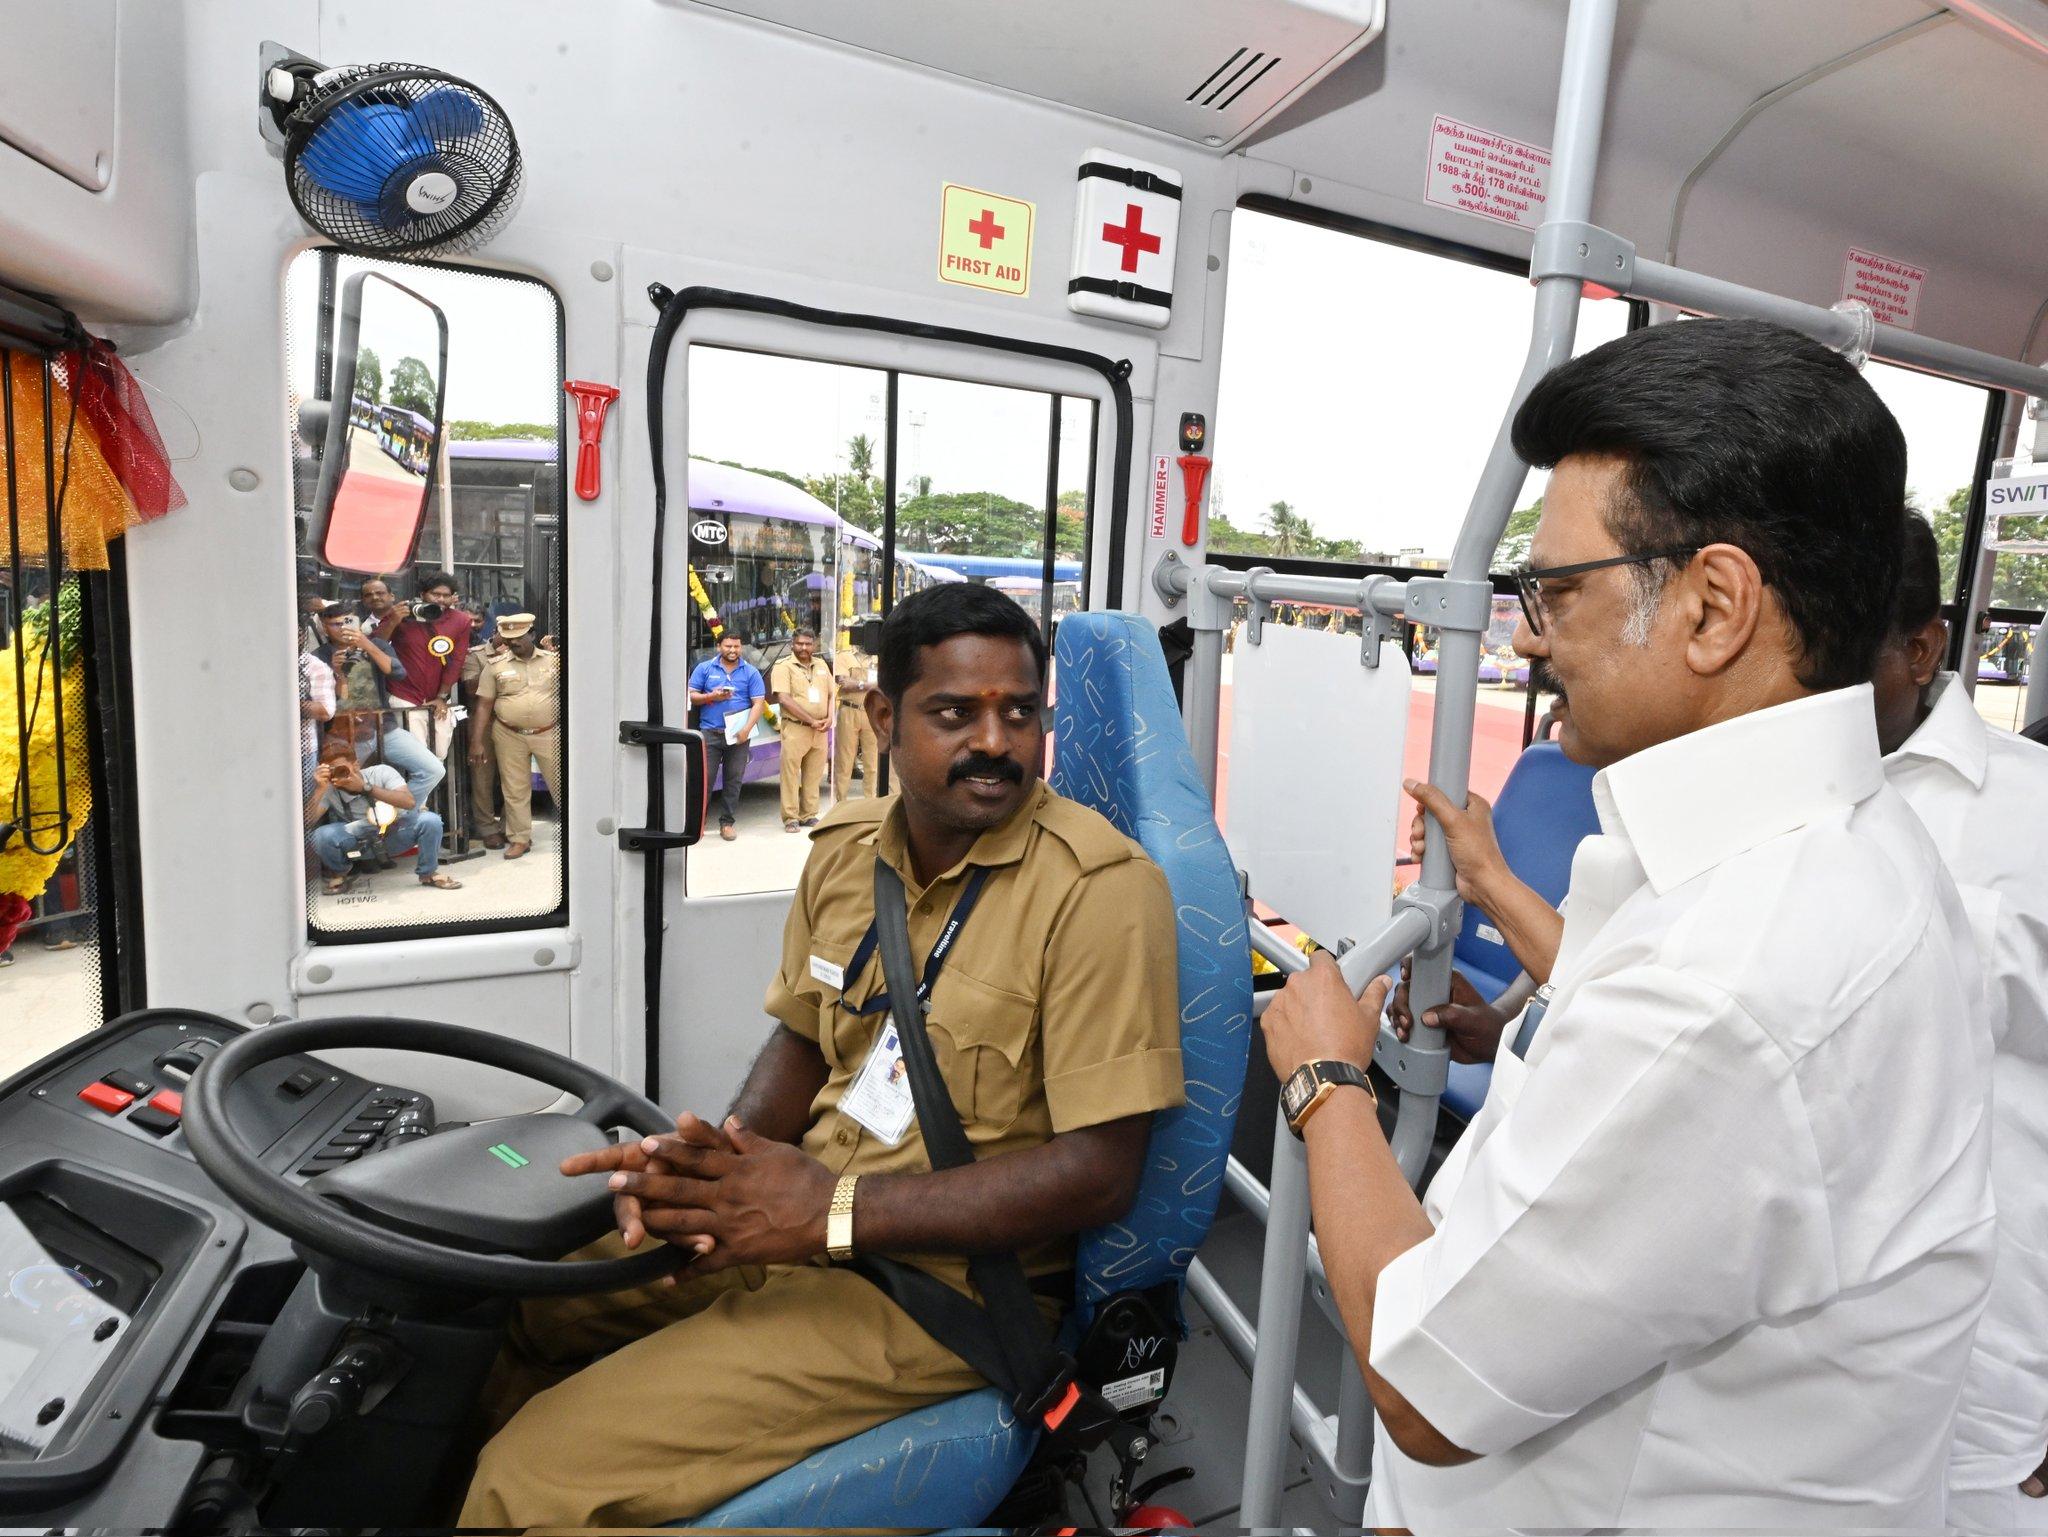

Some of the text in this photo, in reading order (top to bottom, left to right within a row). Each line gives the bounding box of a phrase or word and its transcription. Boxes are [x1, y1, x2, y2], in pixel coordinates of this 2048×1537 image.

[1454, 142, 1487, 159] பயணம்
[1444, 151, 1484, 170] மோட்டார்
[1488, 177, 1505, 190] 178
[1849, 252, 1855, 261] 5
[946, 254, 1021, 282] FIRST AID
[1153, 471, 1167, 536] HAMMER
[697, 525, 725, 540] MTC
[933, 920, 959, 959] traveltime
